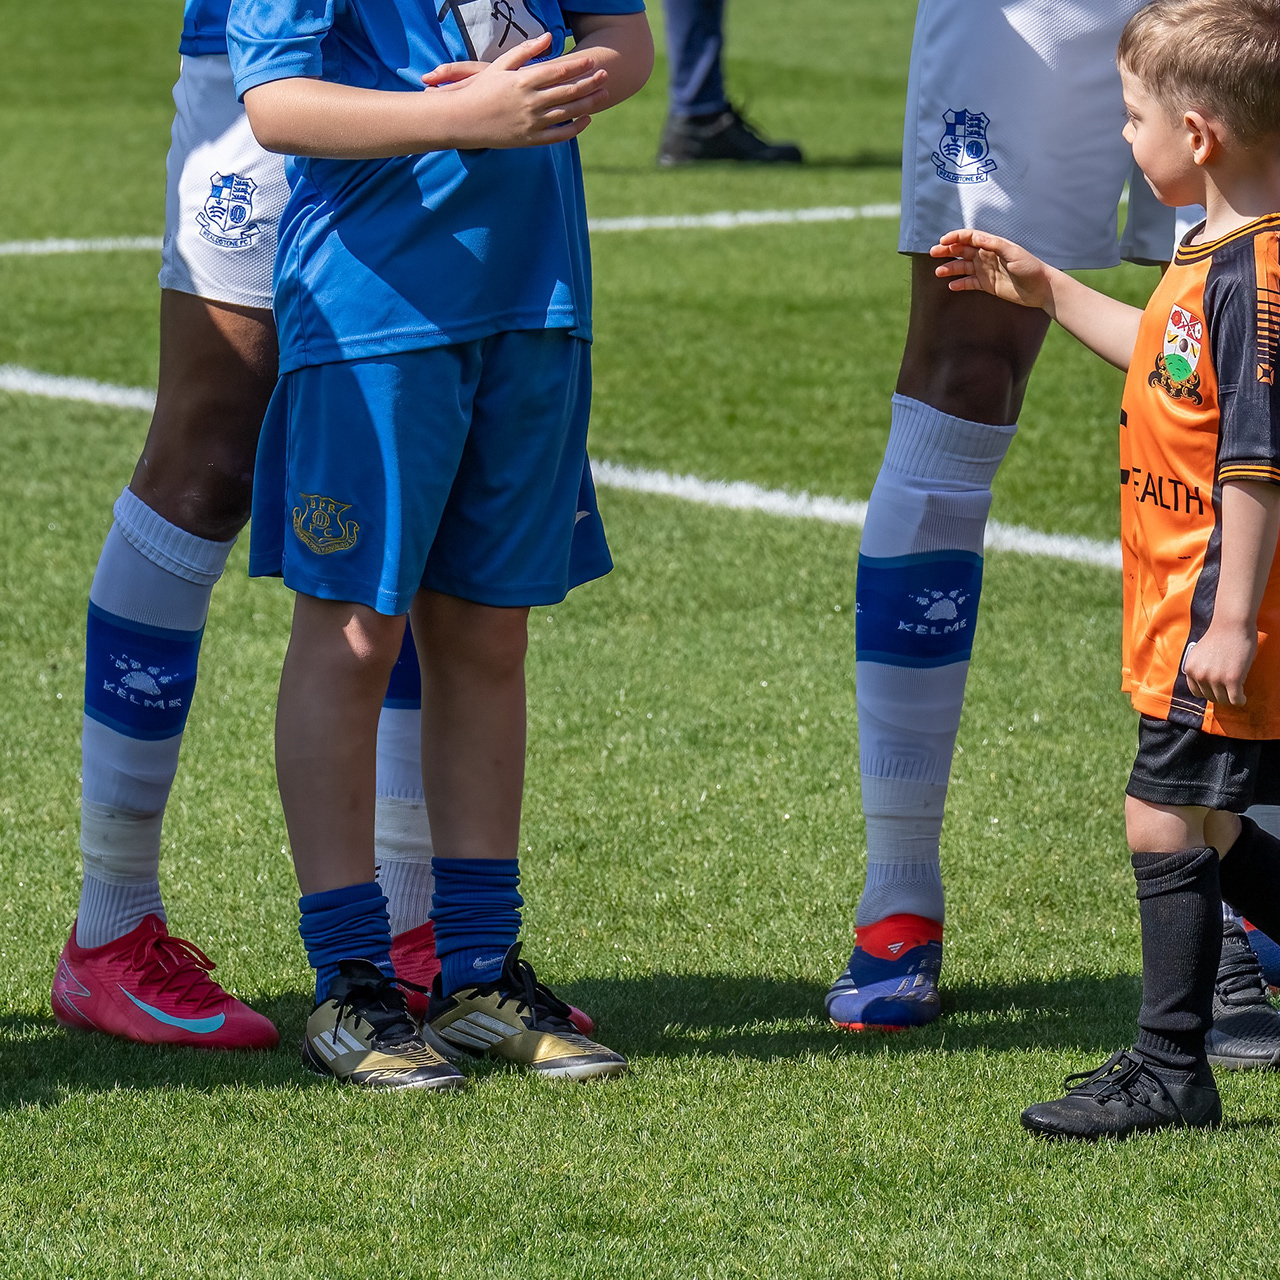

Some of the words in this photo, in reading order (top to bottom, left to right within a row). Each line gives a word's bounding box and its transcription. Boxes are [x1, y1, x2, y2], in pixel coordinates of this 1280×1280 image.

[1132, 466, 1204, 516] EALTH
[897, 618, 968, 635] KELME
[103, 679, 182, 710] KELME
[364, 1068, 418, 1083] F50
